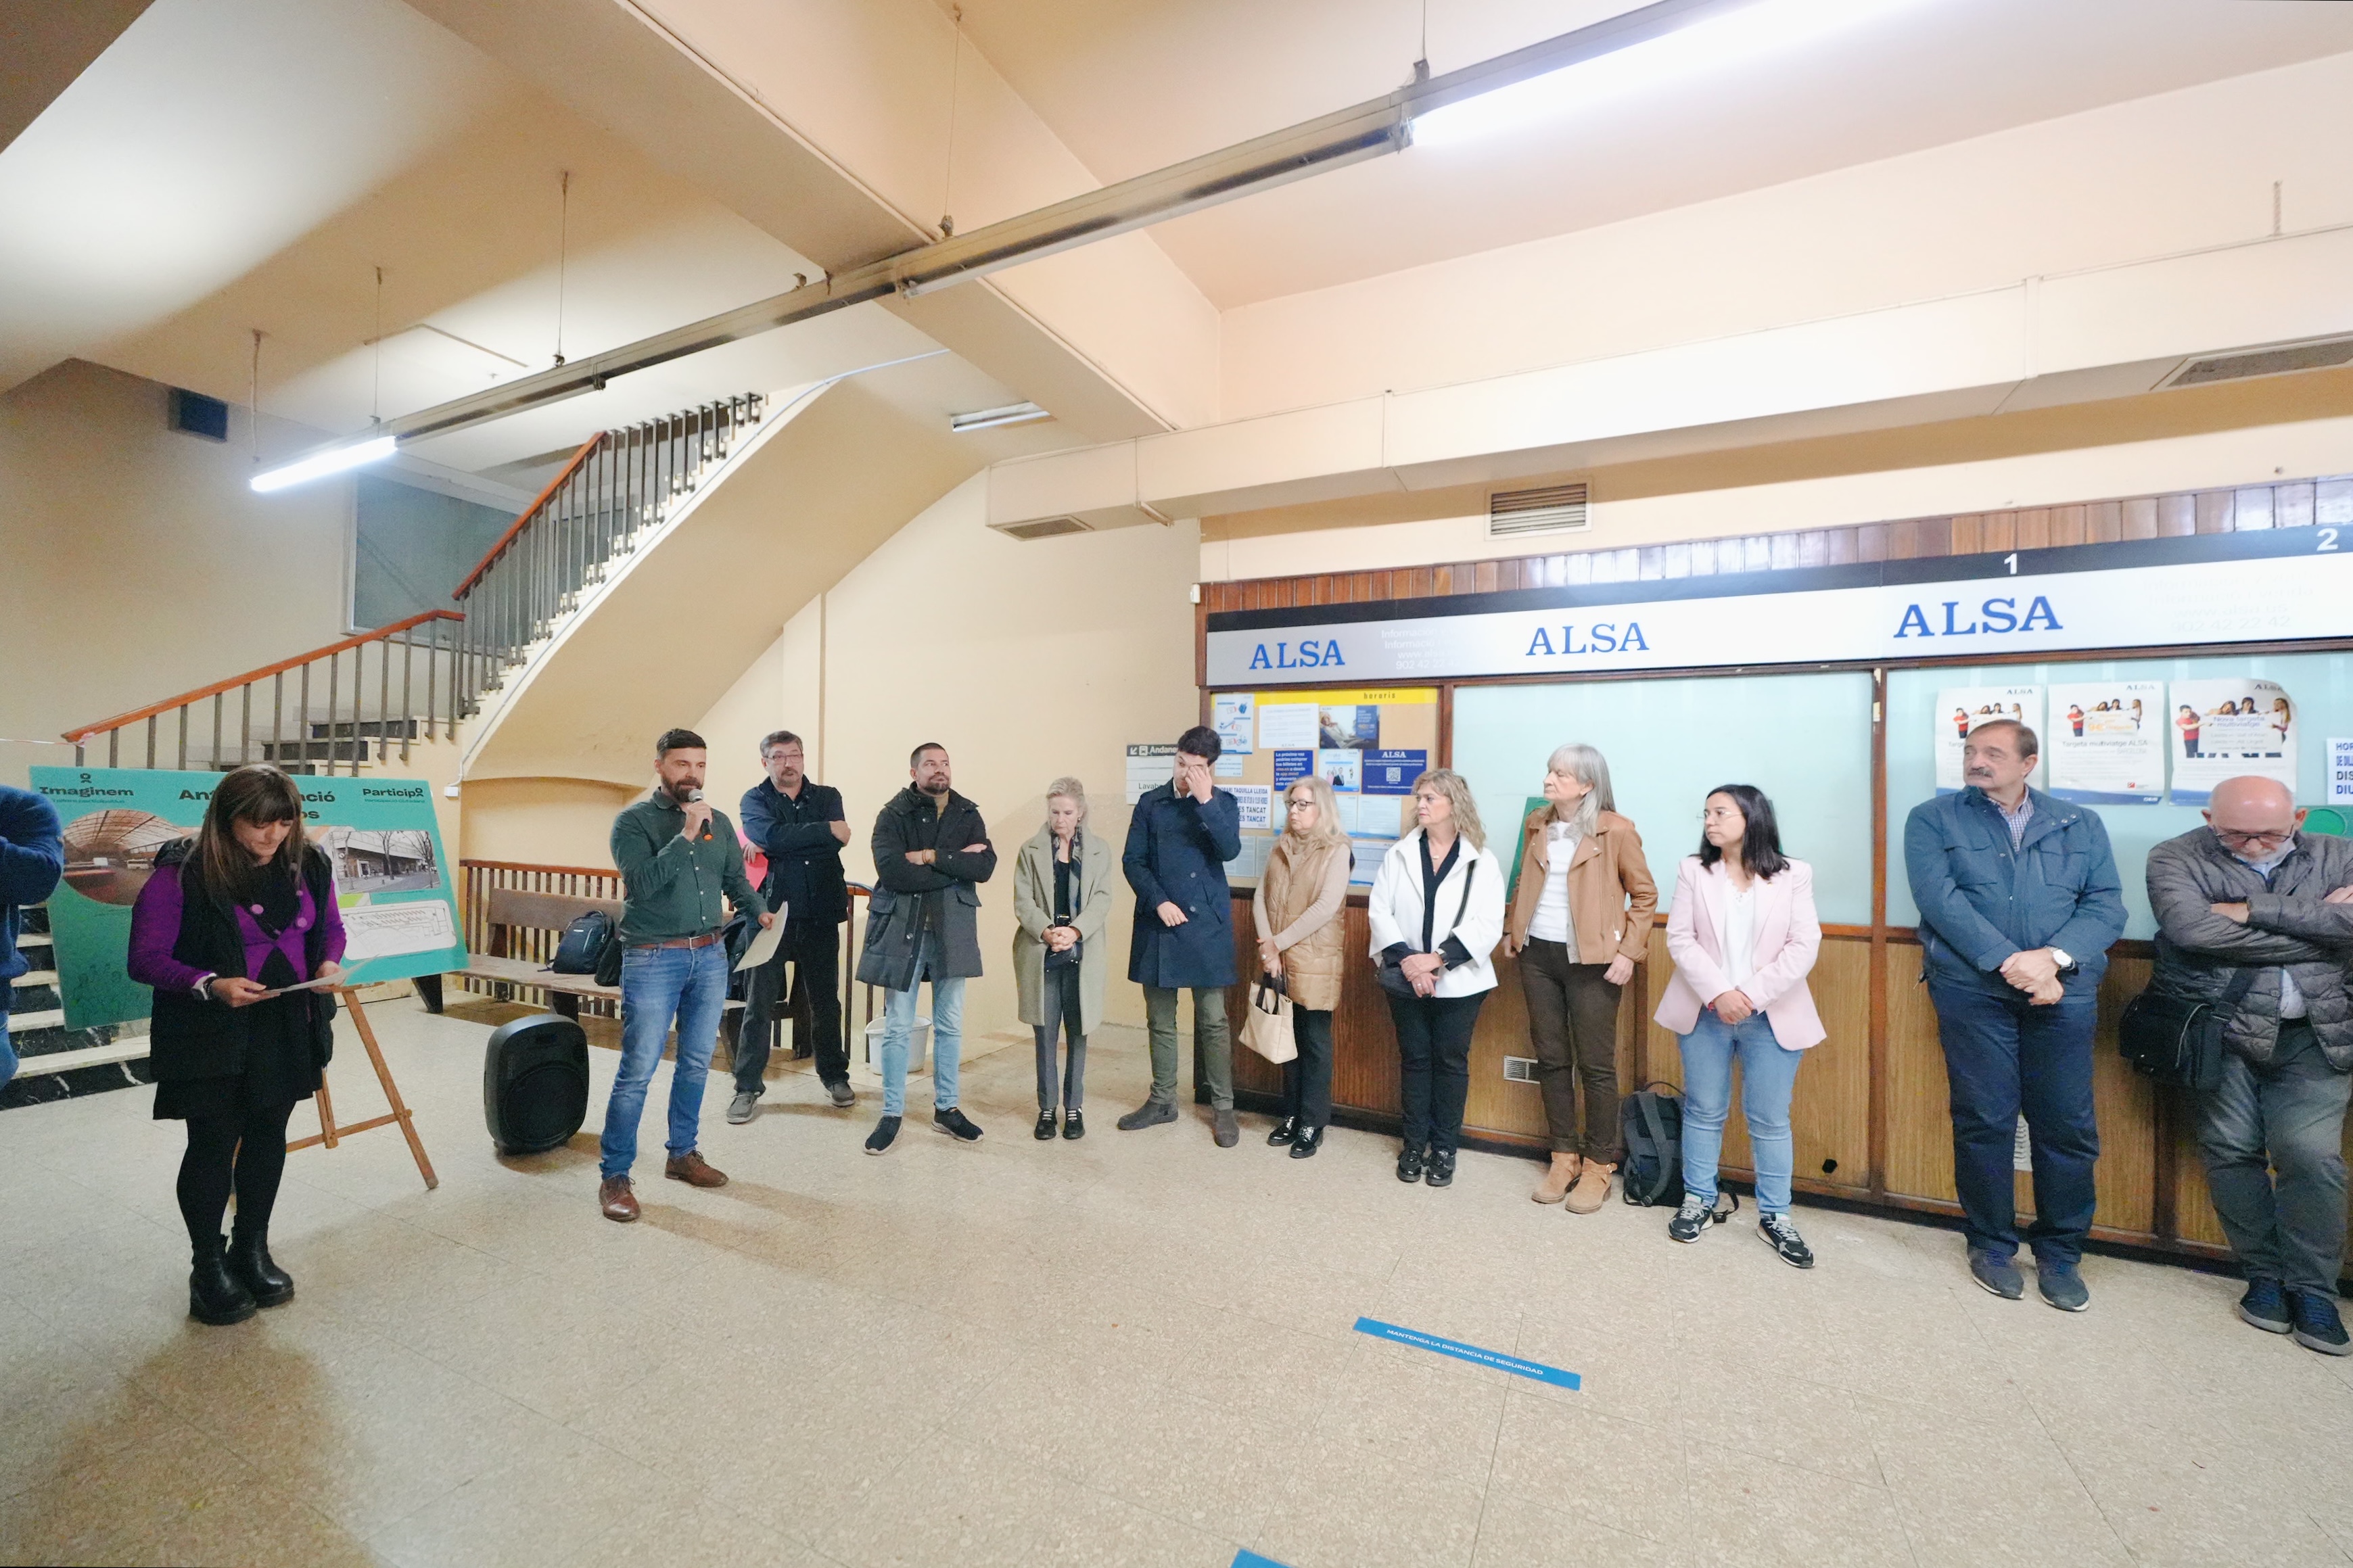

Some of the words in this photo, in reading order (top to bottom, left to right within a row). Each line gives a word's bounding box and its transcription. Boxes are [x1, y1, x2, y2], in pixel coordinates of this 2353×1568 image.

[2315, 528, 2339, 552] 2
[2003, 552, 2018, 575] 1
[1892, 596, 2064, 638] ALSA
[1525, 622, 1650, 657] ALSA
[1249, 639, 1346, 670] ALSA
[1396, 660, 1415, 669] 902
[1417, 659, 1430, 669] 42
[1150, 746, 1179, 754] Andane
[39, 786, 134, 798] Imaginem
[1387, 1329, 1430, 1345] MANTENGA
[1442, 1344, 1483, 1358] DISTANCIA
[1495, 1358, 1543, 1375] SEGURIDAD
